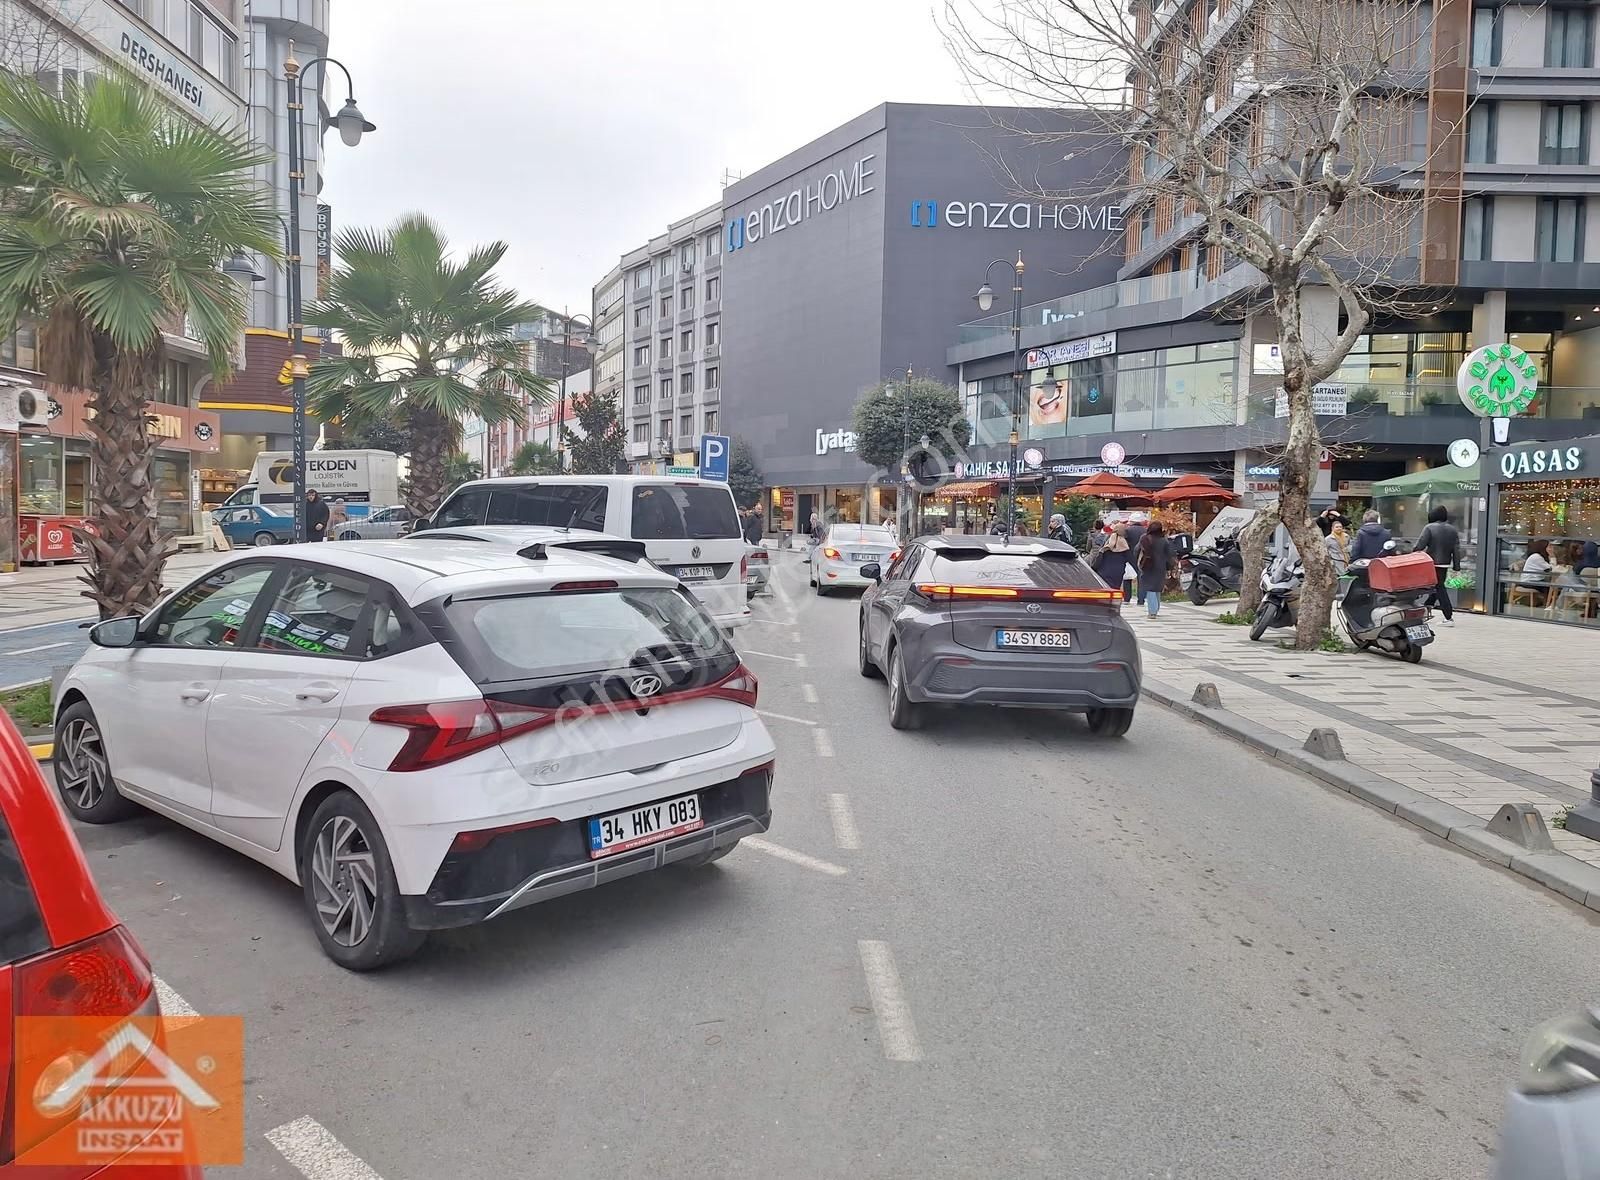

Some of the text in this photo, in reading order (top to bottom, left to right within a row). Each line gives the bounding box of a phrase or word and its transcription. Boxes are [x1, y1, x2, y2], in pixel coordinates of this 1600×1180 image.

[120, 32, 203, 107] DERSHANESİ
[746, 154, 877, 243] enza HOME
[945, 201, 1124, 231] enza HOME
[1469, 343, 1538, 381] QASAS
[1468, 385, 1537, 417] COFFEE
[705, 440, 724, 468] P
[963, 461, 992, 477] KAHVE
[1501, 446, 1581, 479] QASAS
[1004, 632, 1070, 646] 34 SY 8828
[602, 798, 697, 844] 34 HKY 083
